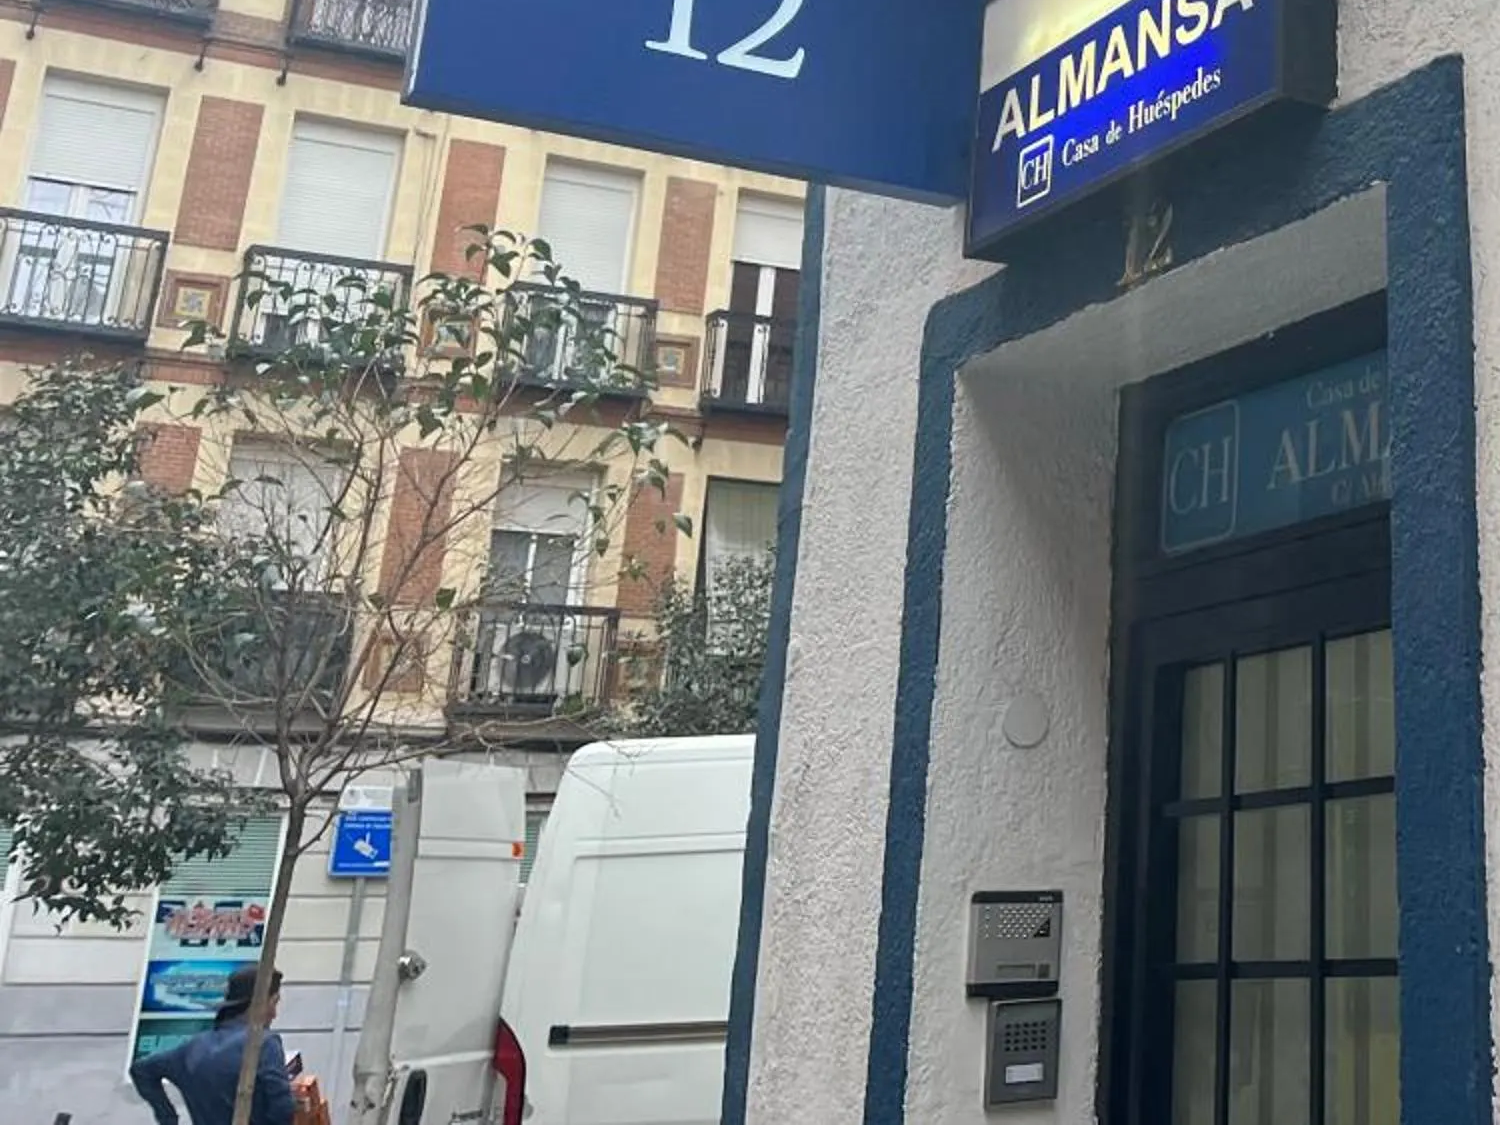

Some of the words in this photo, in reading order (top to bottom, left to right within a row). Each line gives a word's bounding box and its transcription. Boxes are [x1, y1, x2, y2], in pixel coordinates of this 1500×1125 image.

[1021, 150, 1050, 191] CH
[1061, 135, 1099, 166] Casa
[1105, 120, 1122, 145] de
[1127, 67, 1221, 134] Huéspedes
[1306, 379, 1353, 409] Casa
[1359, 365, 1380, 392] de
[1169, 435, 1232, 514] CH
